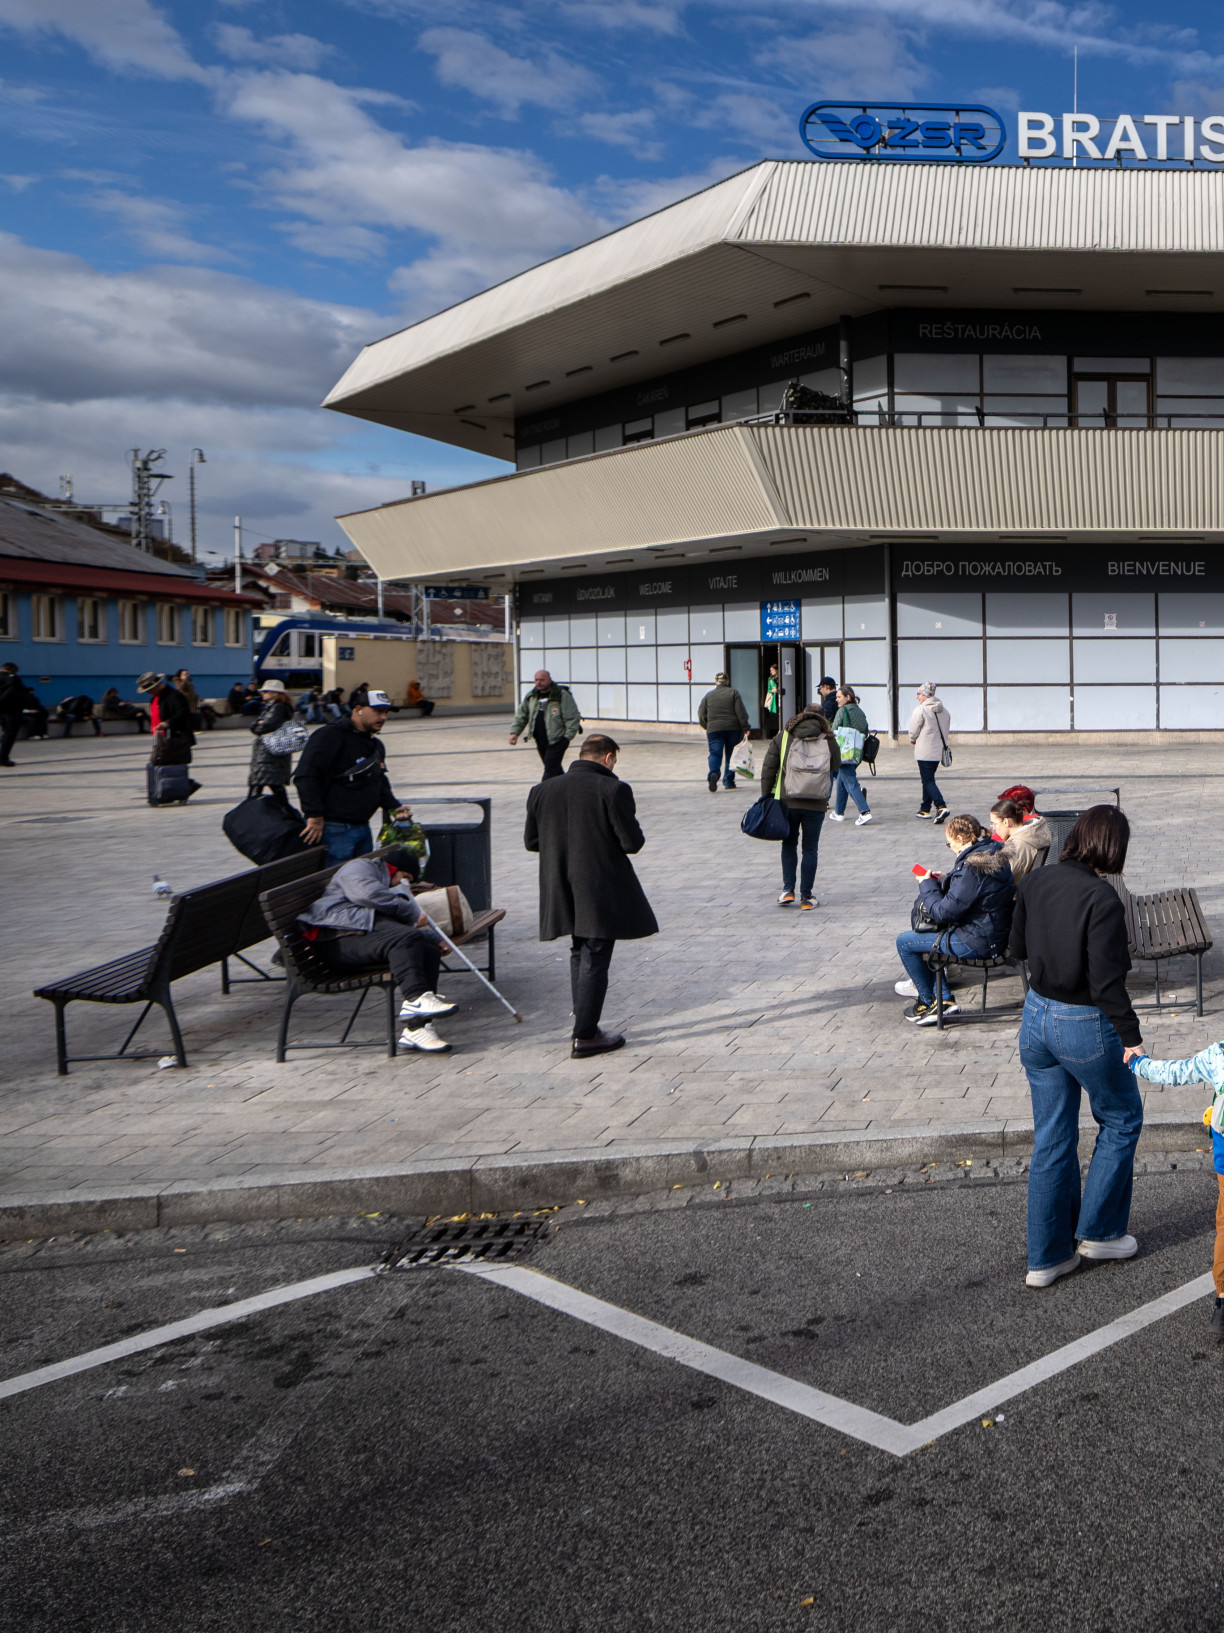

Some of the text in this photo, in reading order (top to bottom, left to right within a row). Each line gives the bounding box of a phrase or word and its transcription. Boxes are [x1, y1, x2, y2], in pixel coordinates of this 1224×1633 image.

[887, 117, 988, 150] ŽSR
[918, 322, 1042, 340] REŠTAURÁCIA
[770, 341, 826, 368] WARTERAUM
[772, 567, 830, 585] WILLKOMMEN
[901, 561, 1062, 577] ДОБРО ПОЖАЛОВАТЬ
[1107, 561, 1206, 576] BIENVENUE
[639, 581, 673, 596] WELCOME
[709, 575, 739, 590] VITAJTE
